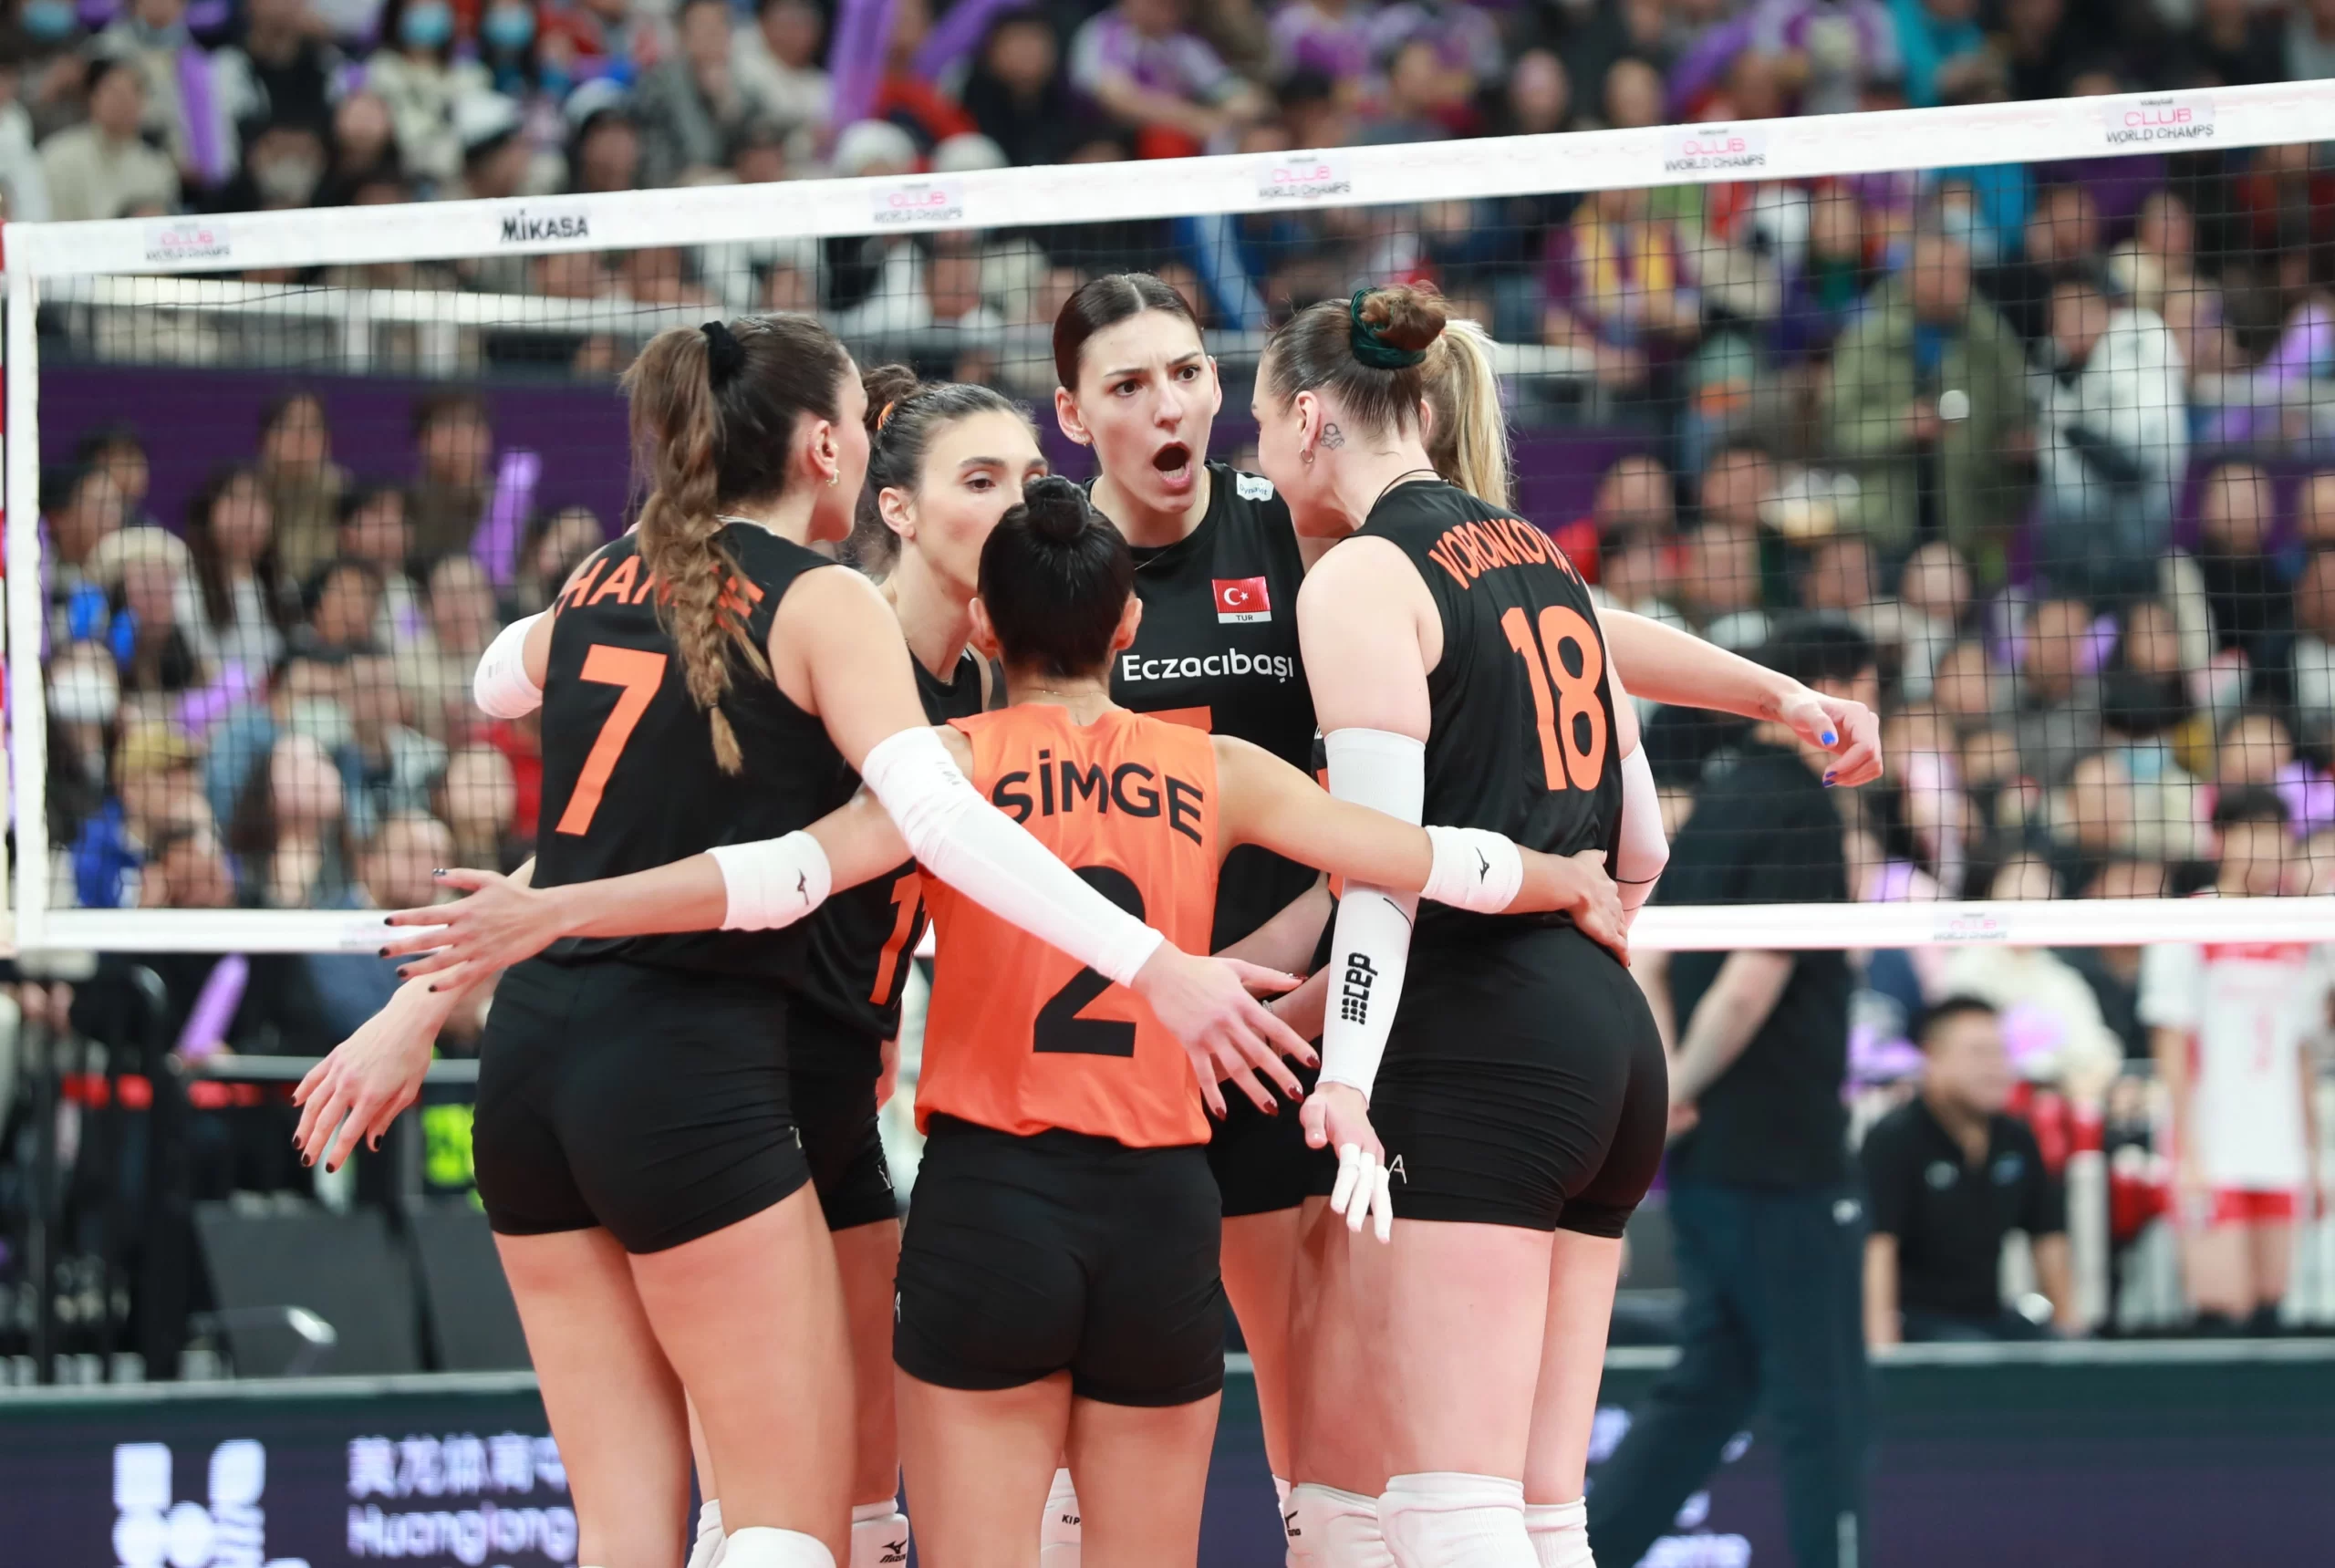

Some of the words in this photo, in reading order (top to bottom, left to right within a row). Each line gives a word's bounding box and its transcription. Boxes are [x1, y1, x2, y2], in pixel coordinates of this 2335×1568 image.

[2124, 108, 2193, 127] CLUB
[2106, 129, 2153, 144] WORLD
[2156, 124, 2215, 139] CHAMPS
[1683, 138, 1746, 155] CLUB
[1665, 157, 1711, 171] WORLD
[1714, 153, 1766, 168] CHAMPS
[1235, 614, 1254, 622] TUR
[1122, 647, 1294, 683] Eczacıbaşı
[1500, 605, 1607, 791] 18
[555, 643, 669, 836] 7
[868, 871, 933, 1011] 1
[1032, 865, 1147, 1058] 2
[1061, 1513, 1082, 1526] KIP
